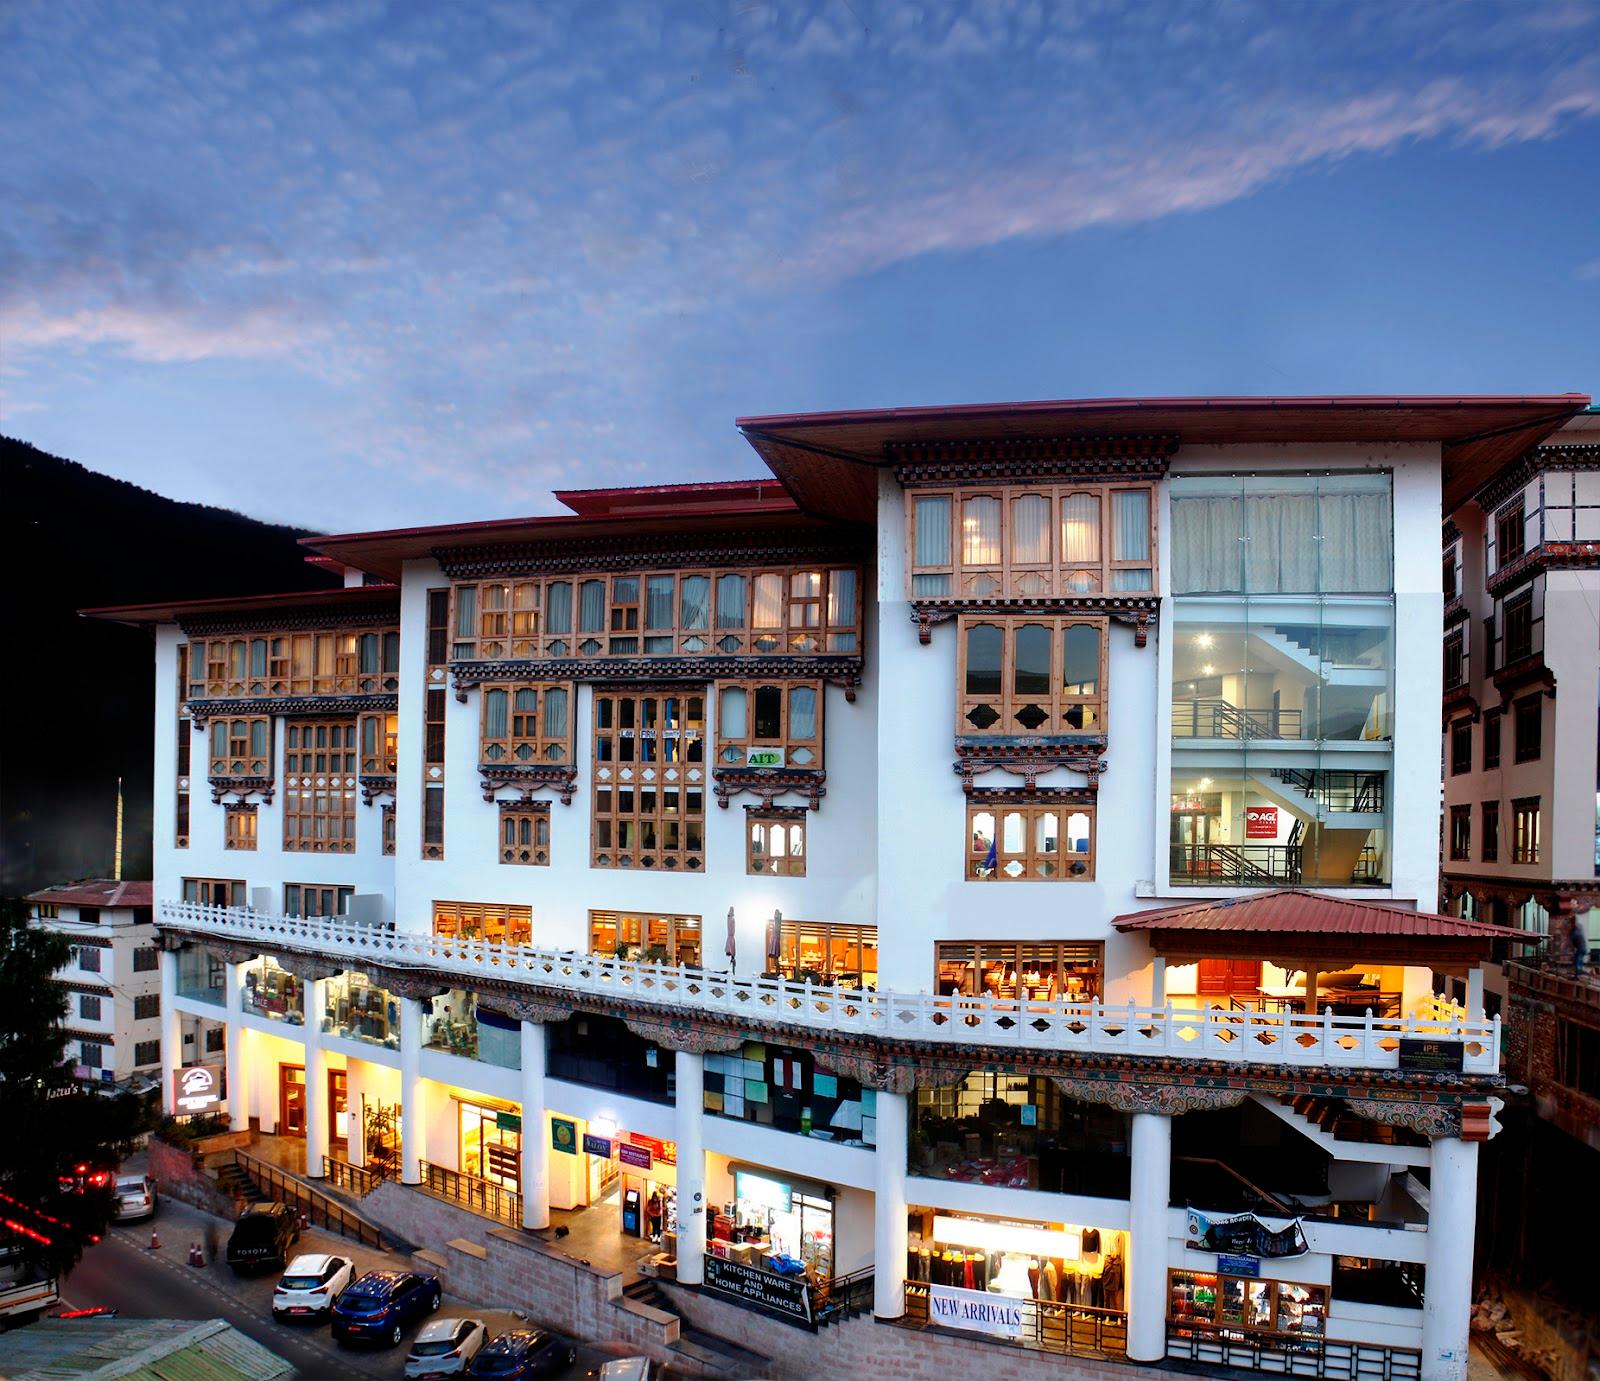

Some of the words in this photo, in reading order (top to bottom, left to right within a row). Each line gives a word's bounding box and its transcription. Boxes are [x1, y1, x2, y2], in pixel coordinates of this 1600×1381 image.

[749, 754, 774, 763] AIT
[1259, 812, 1276, 821] AGL
[254, 997, 268, 1008] SALE
[1423, 1045, 1439, 1053] IPE
[723, 1263, 761, 1281] KITCHEN
[763, 1276, 791, 1291] WARE
[744, 1279, 763, 1290] AND
[715, 1278, 742, 1291] HOME
[743, 1287, 801, 1312] APPLIANCES
[933, 1297, 959, 1316] NEW
[962, 1302, 1020, 1326] ARRIVALS
